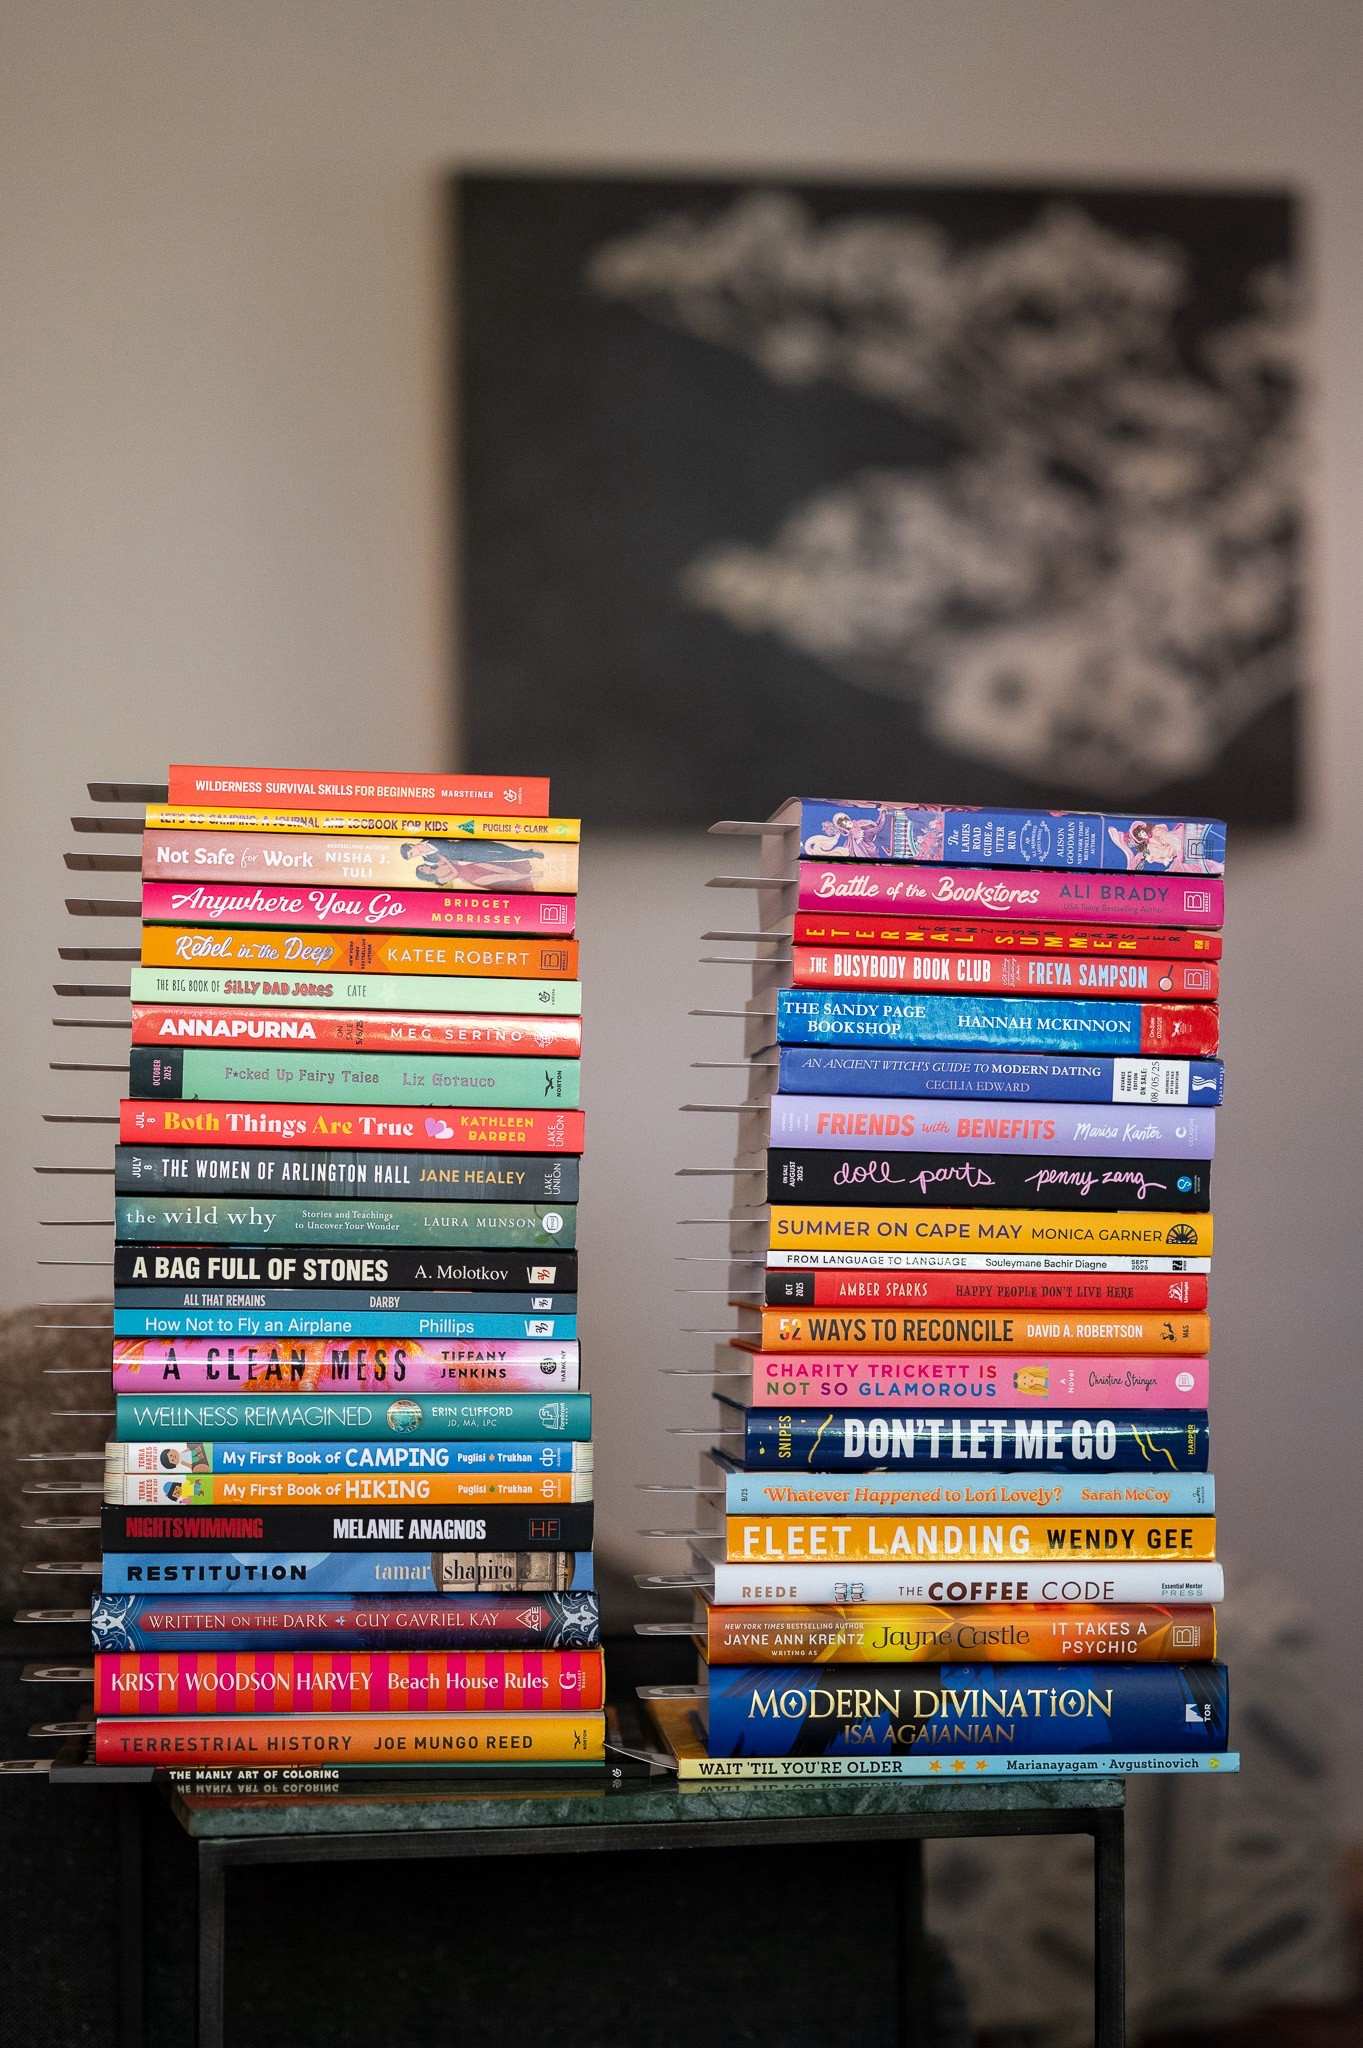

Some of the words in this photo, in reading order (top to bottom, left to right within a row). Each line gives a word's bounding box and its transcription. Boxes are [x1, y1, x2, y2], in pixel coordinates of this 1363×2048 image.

[195, 780, 262, 793] WILDERNESS
[266, 782, 316, 796] SURVIVAL
[317, 784, 353, 797] SKILLS
[354, 785, 375, 797] FOR
[377, 786, 436, 799] BEGINNERS
[441, 789, 494, 799] MARSTEINER
[482, 823, 511, 833] PUGLISI
[523, 824, 549, 834] CLARK
[1056, 827, 1065, 858] ALISON
[1066, 821, 1075, 865] GOODMAN
[325, 852, 373, 864] NISHA
[379, 854, 390, 864] J.
[342, 867, 373, 878] TULI
[813, 872, 880, 898] Battle
[886, 882, 903, 901] of
[905, 884, 927, 898] the
[932, 876, 1041, 911] Bookstores
[1059, 884, 1090, 899] ALI
[1101, 885, 1170, 902] BRADY
[171, 887, 305, 918] Anywhere
[308, 890, 364, 921] You
[364, 893, 407, 924] Go
[444, 897, 511, 909] BRIDGET
[431, 912, 522, 925] MORRISSEY
[388, 948, 446, 963] KATEE
[454, 950, 530, 966] ROBERT
[810, 956, 827, 974] THE
[834, 953, 907, 980] BUSYBODY
[913, 956, 951, 981] BOOK
[957, 958, 991, 982] CLUB
[1028, 962, 1072, 986] FREYA
[1079, 964, 1148, 989] SAMPSON
[159, 1018, 317, 1040] ANNAPURNA
[958, 1015, 1033, 1031] HANNAH
[1036, 1017, 1132, 1033] MCKINNON
[390, 1028, 432, 1039] MEG
[445, 1029, 523, 1042] SERINO
[153, 1059, 161, 1086] OCTOBER
[163, 1065, 172, 1081] 2025
[402, 1073, 425, 1086] Liz
[432, 1073, 496, 1087] Gotauco
[925, 1080, 973, 1090] CECILIA
[976, 1081, 1030, 1092] EDWARD
[1150, 1061, 1160, 1102] 08/05/25
[461, 1116, 534, 1127] KATHLEEN
[816, 1112, 916, 1137] FRIENDS
[921, 1120, 951, 1134] with
[957, 1117, 1056, 1141] BENEFITS
[468, 1131, 526, 1142] BARBER
[1073, 1122, 1119, 1141] Marisa
[1121, 1123, 1163, 1142] Kanter
[420, 1169, 459, 1183] JANE
[464, 1171, 526, 1185] HEALEY
[833, 1160, 905, 1185] doll
[909, 1162, 995, 1194] parts
[1024, 1169, 1099, 1196] penny
[1101, 1171, 1167, 1200] zang
[424, 1217, 469, 1227] LAURA
[476, 1218, 537, 1228] MUNSON
[1031, 1227, 1095, 1241] MONICA
[1098, 1229, 1163, 1242] GARNER
[787, 1254, 819, 1264] FROM
[823, 1255, 884, 1265] LANGUAGE
[888, 1256, 902, 1265] TO
[906, 1257, 967, 1267] LANGUAGE
[985, 1258, 1042, 1269] Souleymane
[1044, 1259, 1073, 1268] Bachir
[1075, 1260, 1107, 1270] Diagne
[414, 1265, 432, 1279] A.
[437, 1265, 509, 1280] Molotkov
[839, 1282, 880, 1297] AMBER
[886, 1282, 928, 1297] SPARKS
[184, 1294, 199, 1306] ALL
[202, 1294, 224, 1306] THAT
[226, 1295, 266, 1307] REMAINS
[369, 1296, 400, 1308] DARBY
[419, 1319, 475, 1336] Phillips
[1027, 1324, 1060, 1338] DAVID
[1063, 1324, 1074, 1338] A.
[1077, 1324, 1143, 1338] ROBERTSON
[441, 1351, 507, 1361] TIFFANY
[440, 1368, 507, 1379] JENKINS
[766, 1363, 859, 1378] CHARITY
[868, 1364, 970, 1378] TRICKETT
[979, 1365, 997, 1379] IS
[766, 1382, 810, 1396] NOT
[820, 1382, 848, 1396] SO
[858, 1383, 997, 1397] GLAMOROUS
[133, 1406, 239, 1426] WELLNESS
[245, 1406, 373, 1426] REIMAGINED
[432, 1407, 457, 1417] ERIN
[461, 1407, 514, 1417] CLIFFORD
[778, 1415, 792, 1458] SNIPES
[457, 1453, 486, 1464] Puglisi
[497, 1453, 532, 1463] Trukhan
[1081, 1487, 1121, 1502] Sarah
[1125, 1487, 1172, 1504] McCoy
[126, 1517, 264, 1539] NIGHTSWIMMING
[333, 1518, 404, 1540] MELANIE
[408, 1519, 487, 1540] ANAGNOS
[743, 1525, 852, 1555] FLEET
[868, 1524, 1030, 1555] LANDING
[1046, 1529, 1135, 1550] WENDY
[1147, 1529, 1193, 1549] GEE
[127, 1564, 307, 1581] RESTITUTION
[375, 1562, 431, 1580] tamar
[443, 1559, 512, 1585] shapiro
[742, 1586, 797, 1598] REEDE
[898, 1586, 923, 1596] THE
[928, 1581, 1028, 1601] COFFEE
[1042, 1581, 1115, 1600] CODE
[355, 1613, 390, 1627] GUY
[396, 1613, 464, 1627] GAVRIEL
[470, 1612, 499, 1626] KAY
[531, 1606, 539, 1631] ACE
[1052, 1622, 1068, 1635] IT
[1075, 1622, 1130, 1636] TAKES
[1137, 1622, 1148, 1635] A
[724, 1634, 769, 1646] JAYNE
[774, 1634, 803, 1645] ANN
[809, 1633, 865, 1645] KRENTZ
[1062, 1640, 1138, 1654] PSYCHIC
[111, 1672, 180, 1691] KRISTY
[185, 1672, 290, 1691] WOODSON
[297, 1672, 374, 1691] HARVEY
[747, 1688, 902, 1718] MODERN
[844, 1724, 876, 1744] ISA
[882, 1724, 1015, 1744] AGAJANIAN
[120, 1736, 259, 1752] TERRESTRIAL
[267, 1735, 352, 1751] HISTORY
[374, 1736, 407, 1750] JOE
[414, 1736, 479, 1750] MUNGO
[486, 1735, 533, 1749] REED
[699, 1763, 743, 1775] WAIT
[847, 1761, 903, 1773] OLDER
[1006, 1759, 1098, 1772] Marianayagam
[1109, 1758, 1200, 1770] Avgustinovich
[169, 1770, 191, 1780] THE
[195, 1770, 233, 1780] MANLY
[237, 1770, 259, 1780] ART
[263, 1770, 278, 1779] OF
[283, 1770, 340, 1779] COLORING
